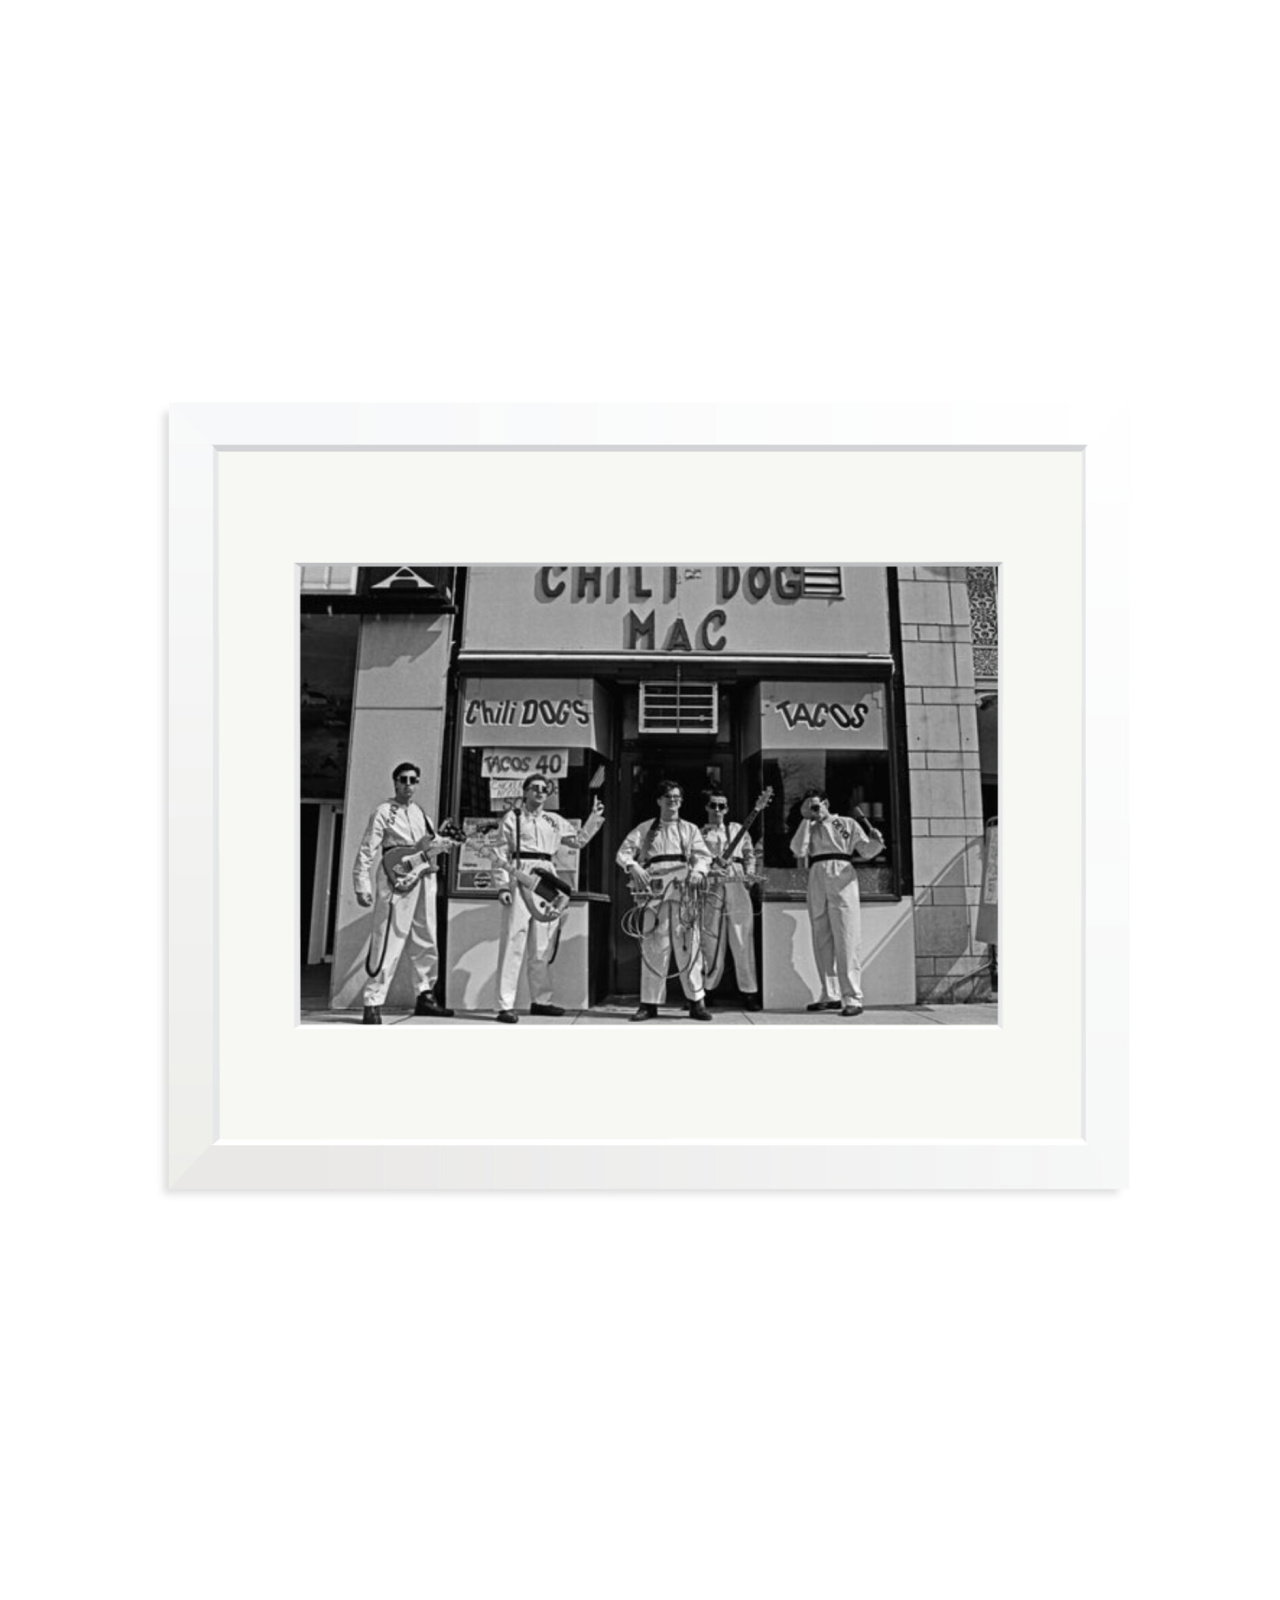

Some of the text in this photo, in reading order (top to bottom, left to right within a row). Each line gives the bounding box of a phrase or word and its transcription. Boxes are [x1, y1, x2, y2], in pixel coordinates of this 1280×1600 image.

[536, 567, 677, 602] CHILI
[624, 609, 727, 651] MAC
[465, 699, 590, 727] Chili DOGS
[776, 700, 869, 731] TACOS
[484, 754, 562, 774] TACOS 40
